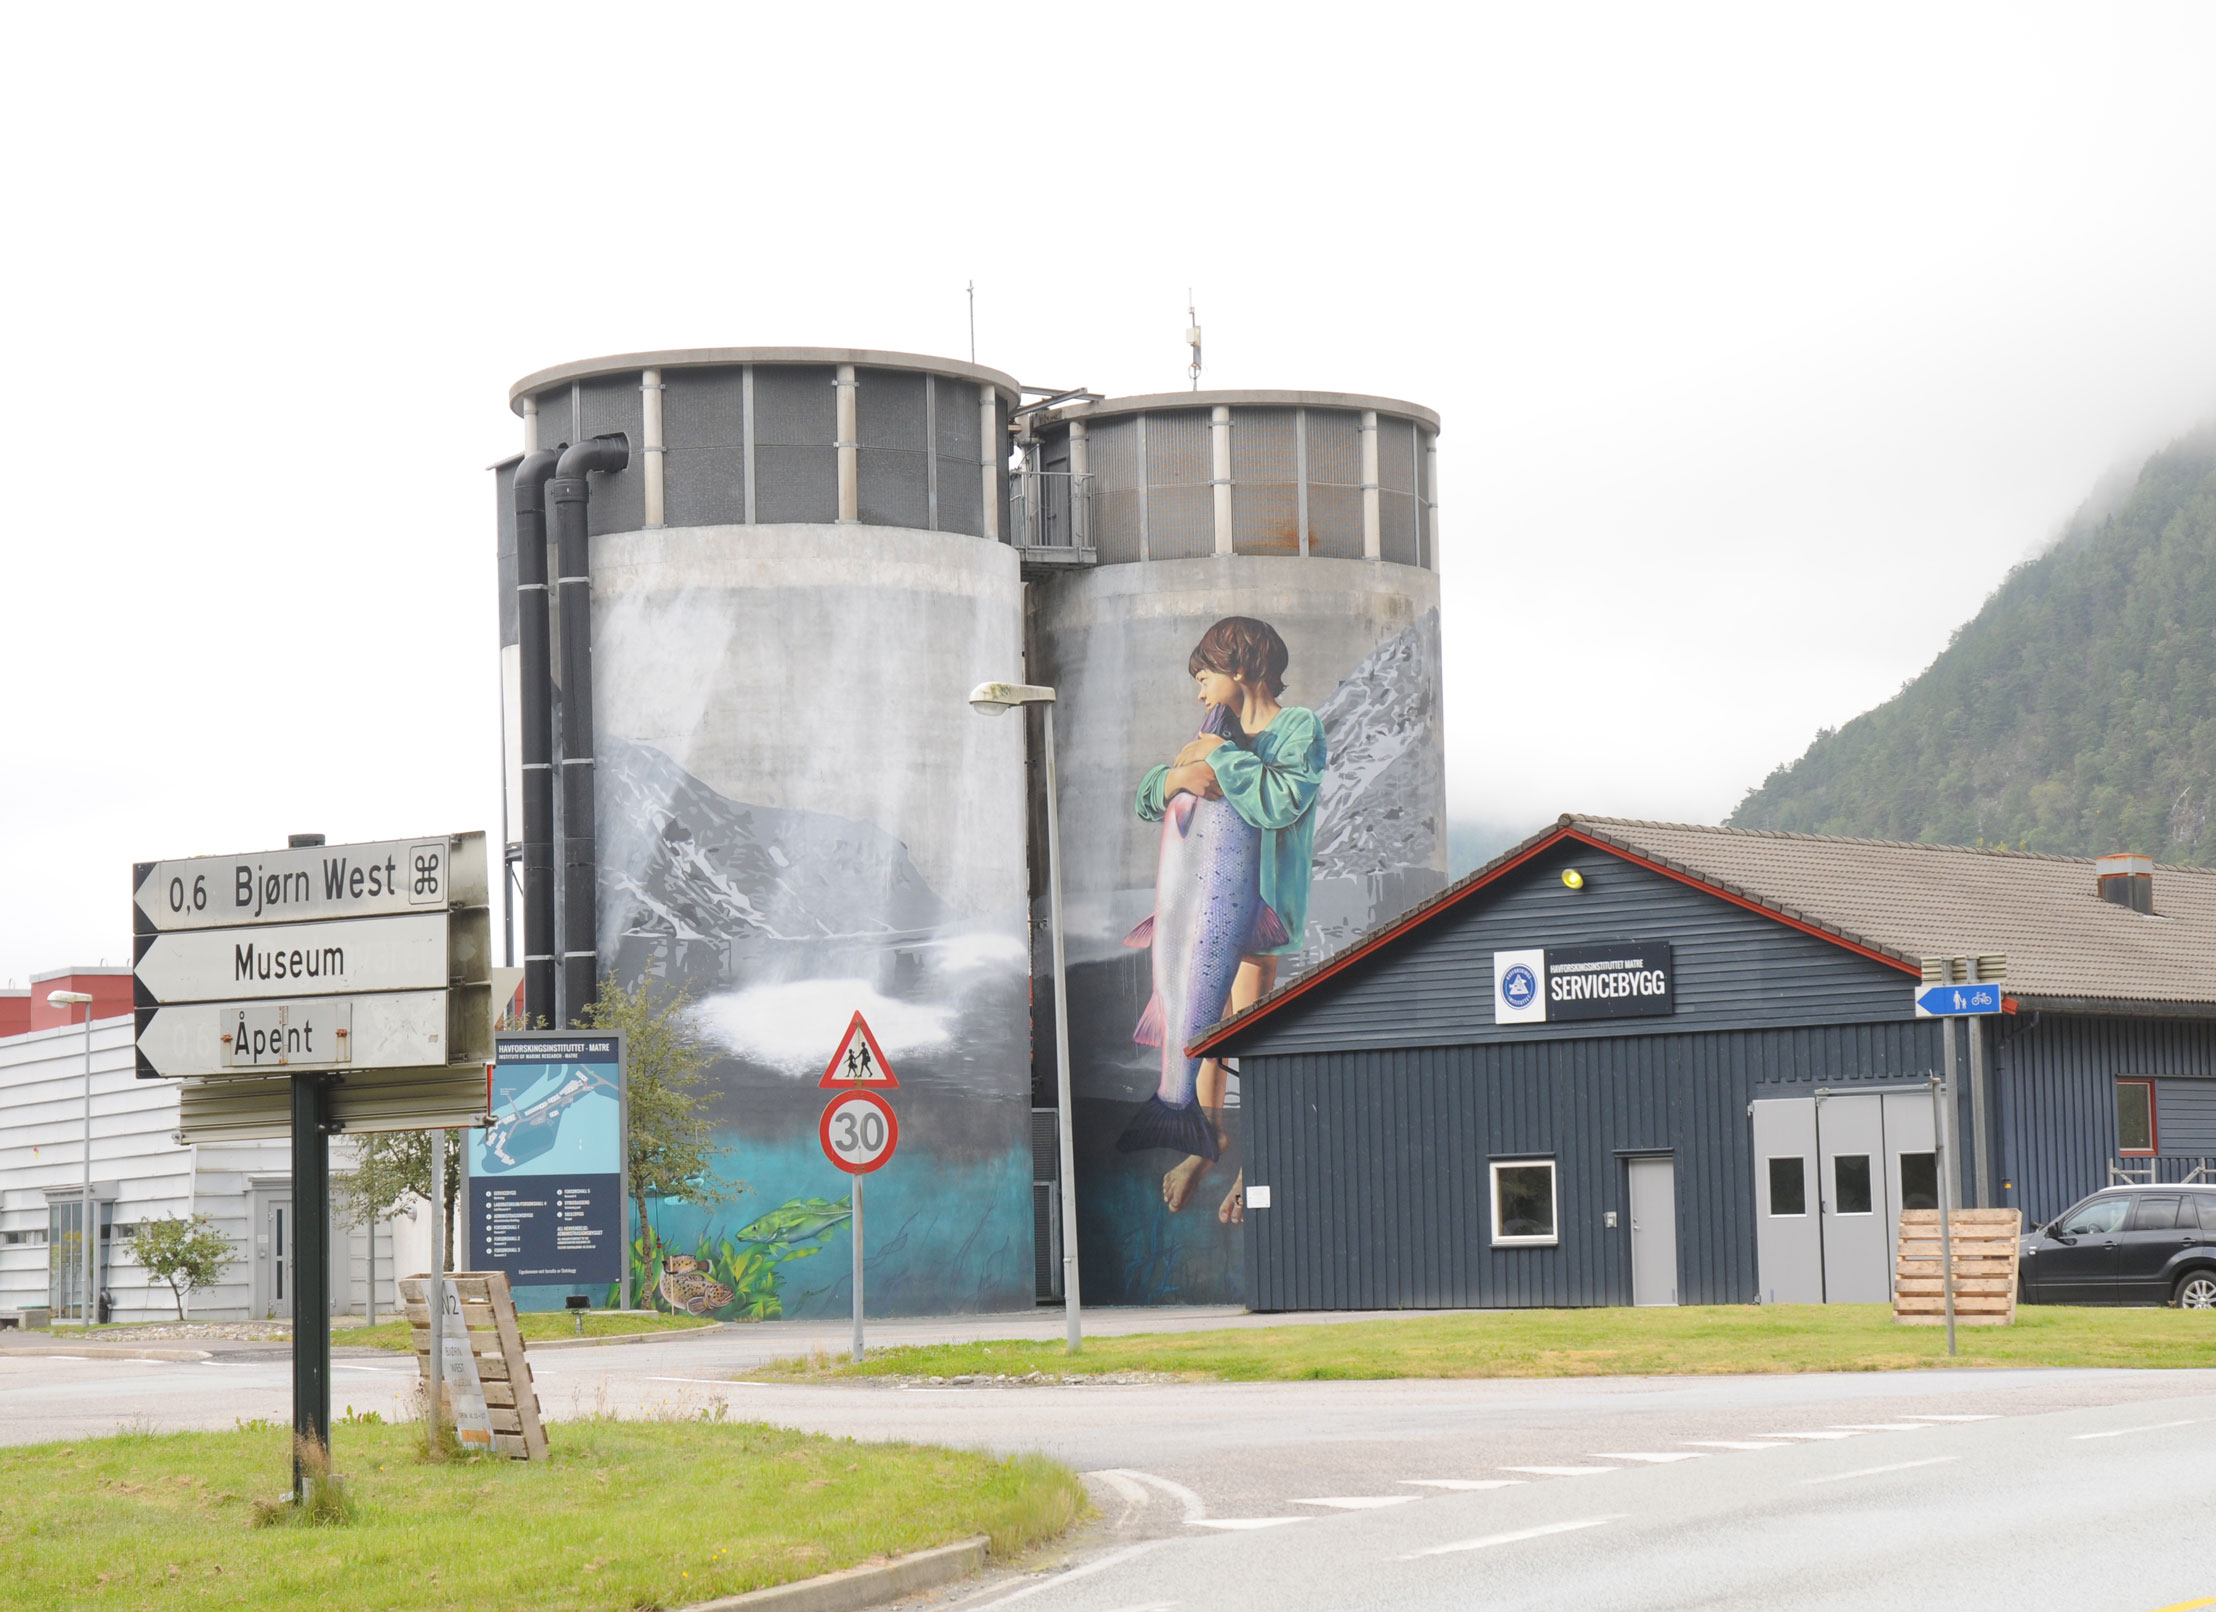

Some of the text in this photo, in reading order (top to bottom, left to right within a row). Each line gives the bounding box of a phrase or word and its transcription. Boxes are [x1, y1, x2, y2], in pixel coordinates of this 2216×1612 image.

[170, 854, 396, 917] 0,6 Bjørn West
[235, 943, 344, 981] Museum
[1551, 970, 1665, 1001] SERVICEBYGG
[234, 1010, 313, 1063] Åpent
[589, 1043, 610, 1052] MATRE
[834, 1112, 884, 1152] 30
